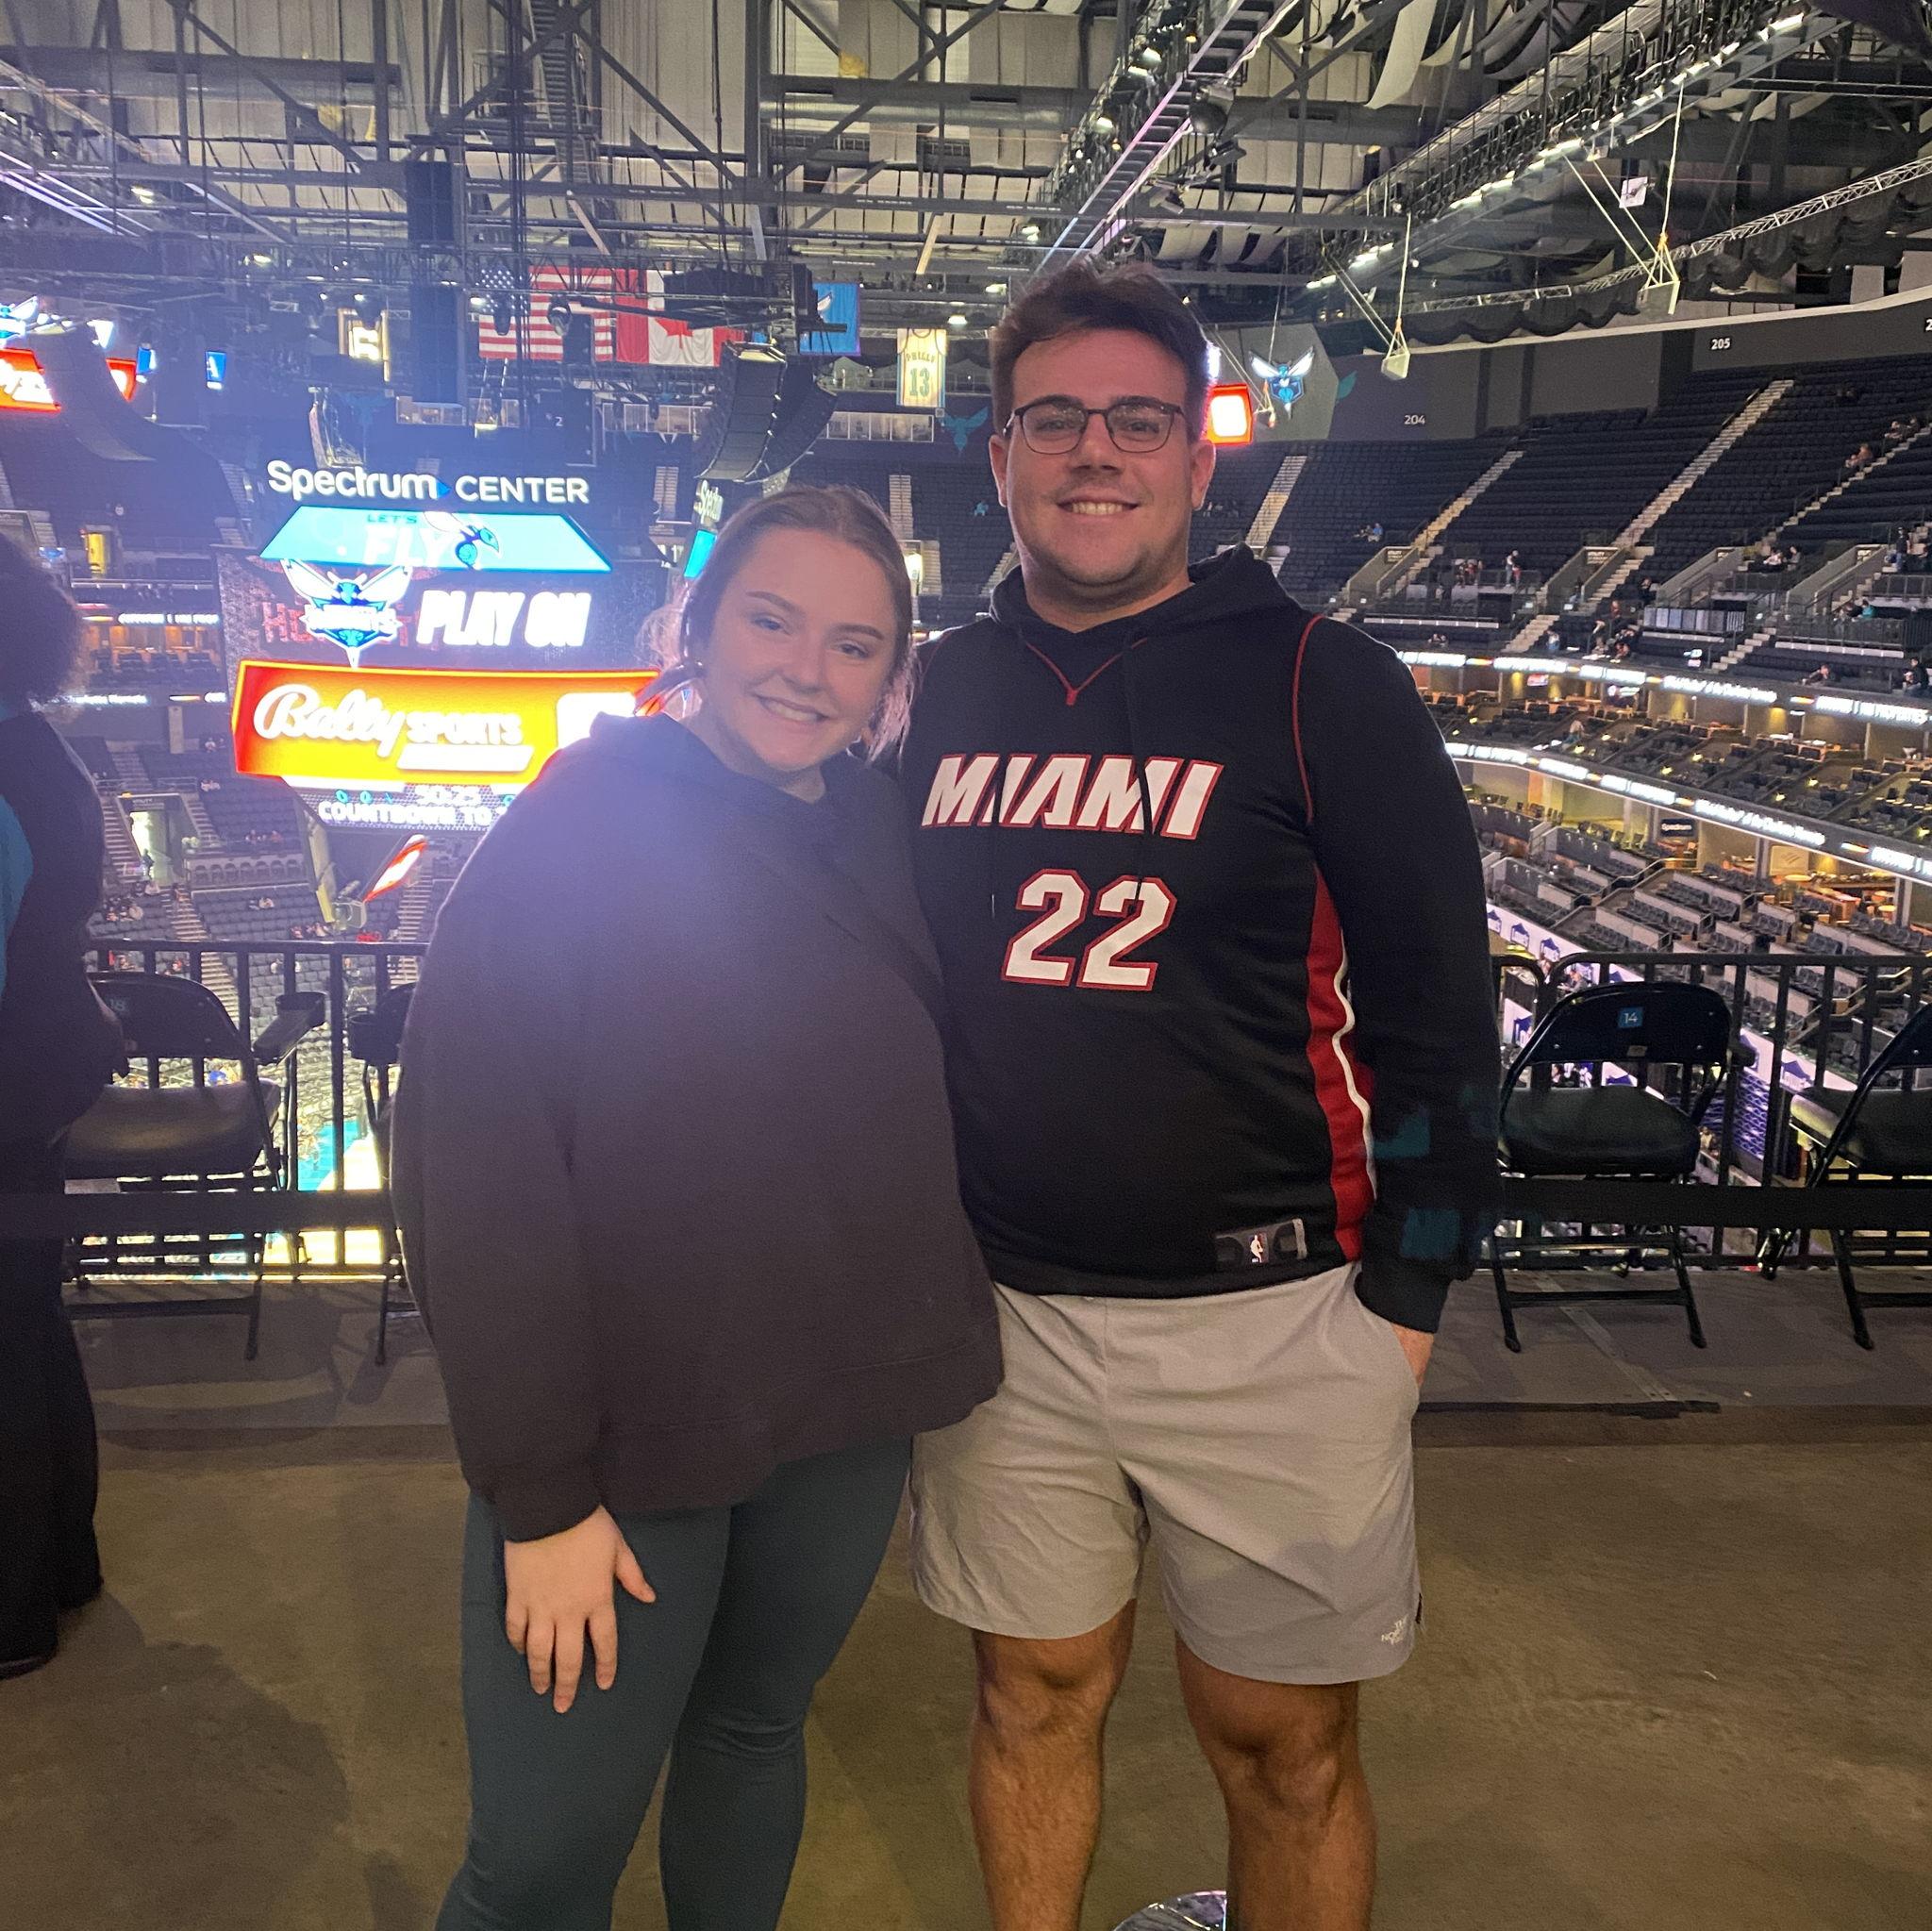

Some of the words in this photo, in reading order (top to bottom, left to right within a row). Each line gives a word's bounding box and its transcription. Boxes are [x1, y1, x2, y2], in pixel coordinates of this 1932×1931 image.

[1711, 338, 1730, 350] 205
[909, 368, 930, 396] 13
[1405, 415, 1425, 424] 204
[267, 459, 440, 501] Spectrum
[455, 474, 590, 504] CENTER
[367, 513, 418, 524] LET'S
[362, 525, 452, 569] FLY
[416, 590, 525, 646] PLAY
[524, 591, 591, 647] ON
[253, 683, 406, 757] Bally
[405, 710, 524, 745] SPORTS
[318, 800, 457, 825] COUNTDOWN
[920, 753, 1224, 841] MIAMI
[1001, 868, 1177, 991] 22
[1624, 1012, 1639, 1024] 14
